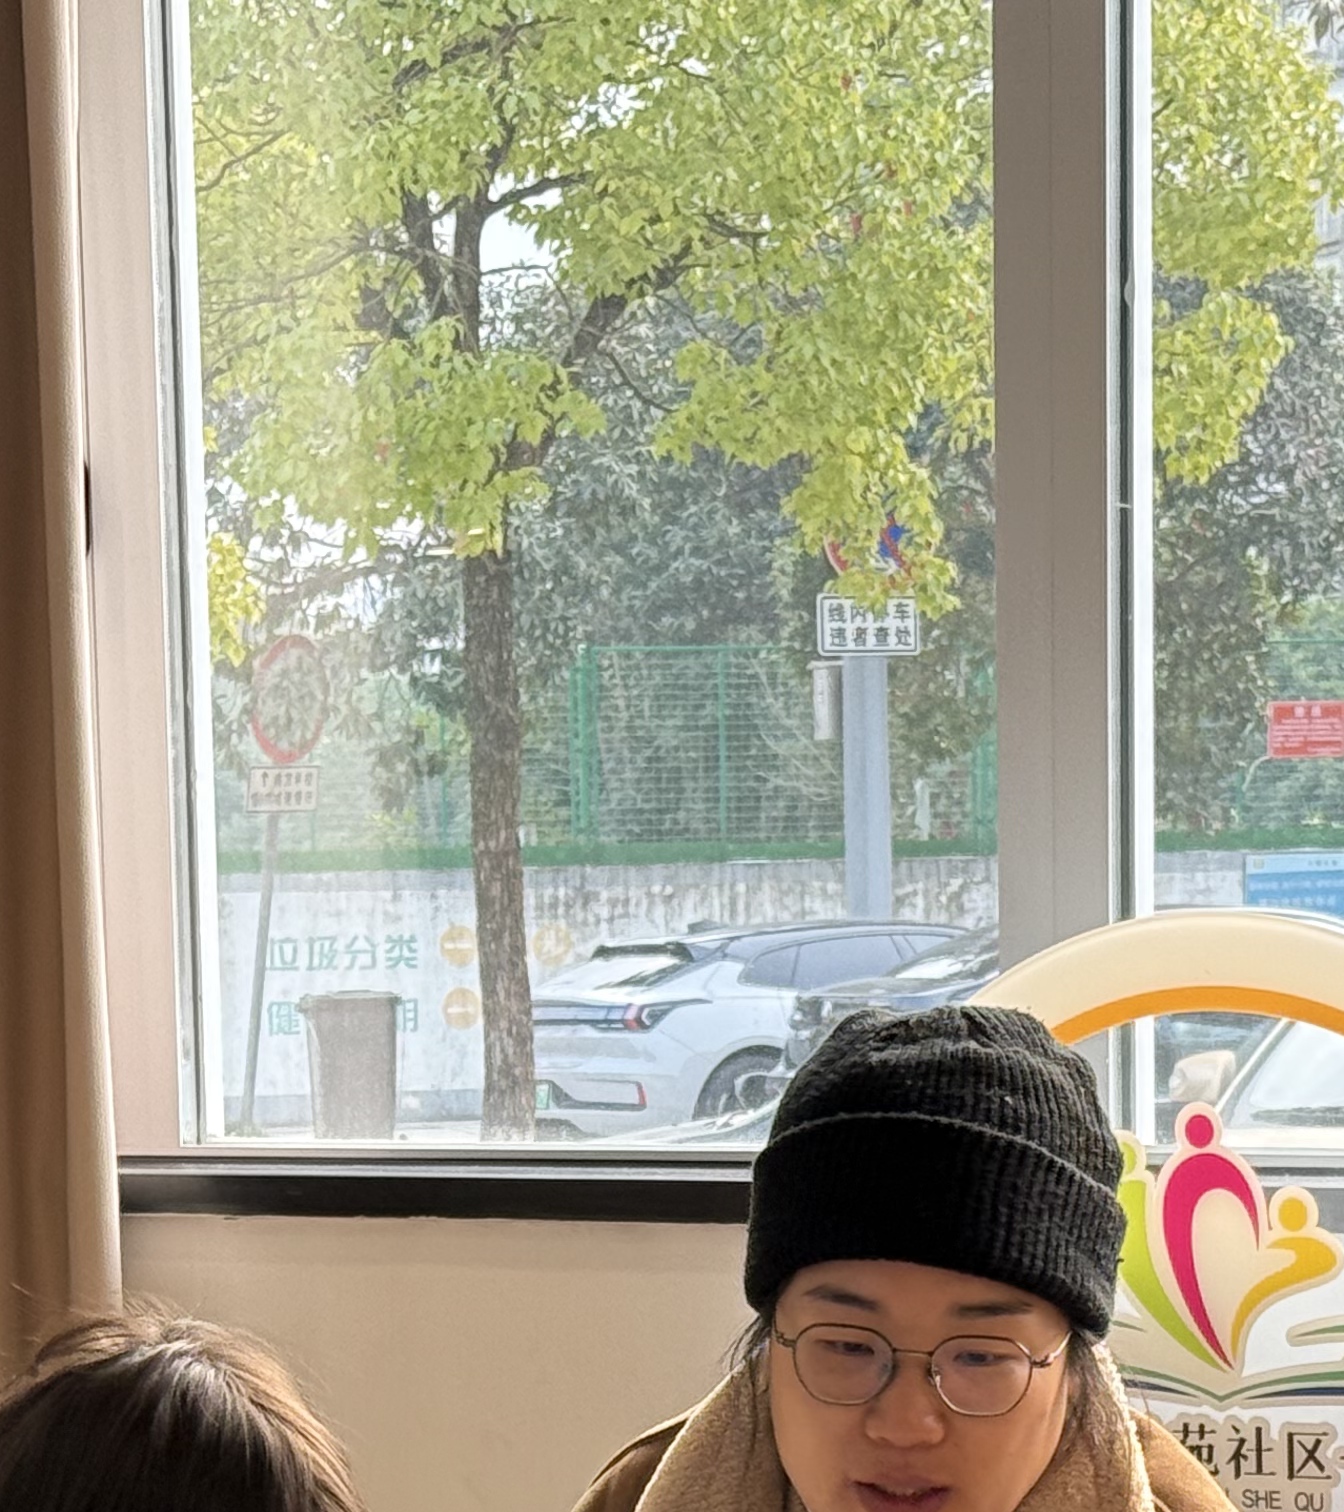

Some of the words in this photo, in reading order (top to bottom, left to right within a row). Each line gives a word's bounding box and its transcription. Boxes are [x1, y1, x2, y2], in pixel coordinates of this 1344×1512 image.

[828, 601, 911, 624] 线内车
[829, 626, 912, 647] 违者查处
[1241, 1488, 1282, 1510] SHE
[1294, 1491, 1325, 1512] QU
